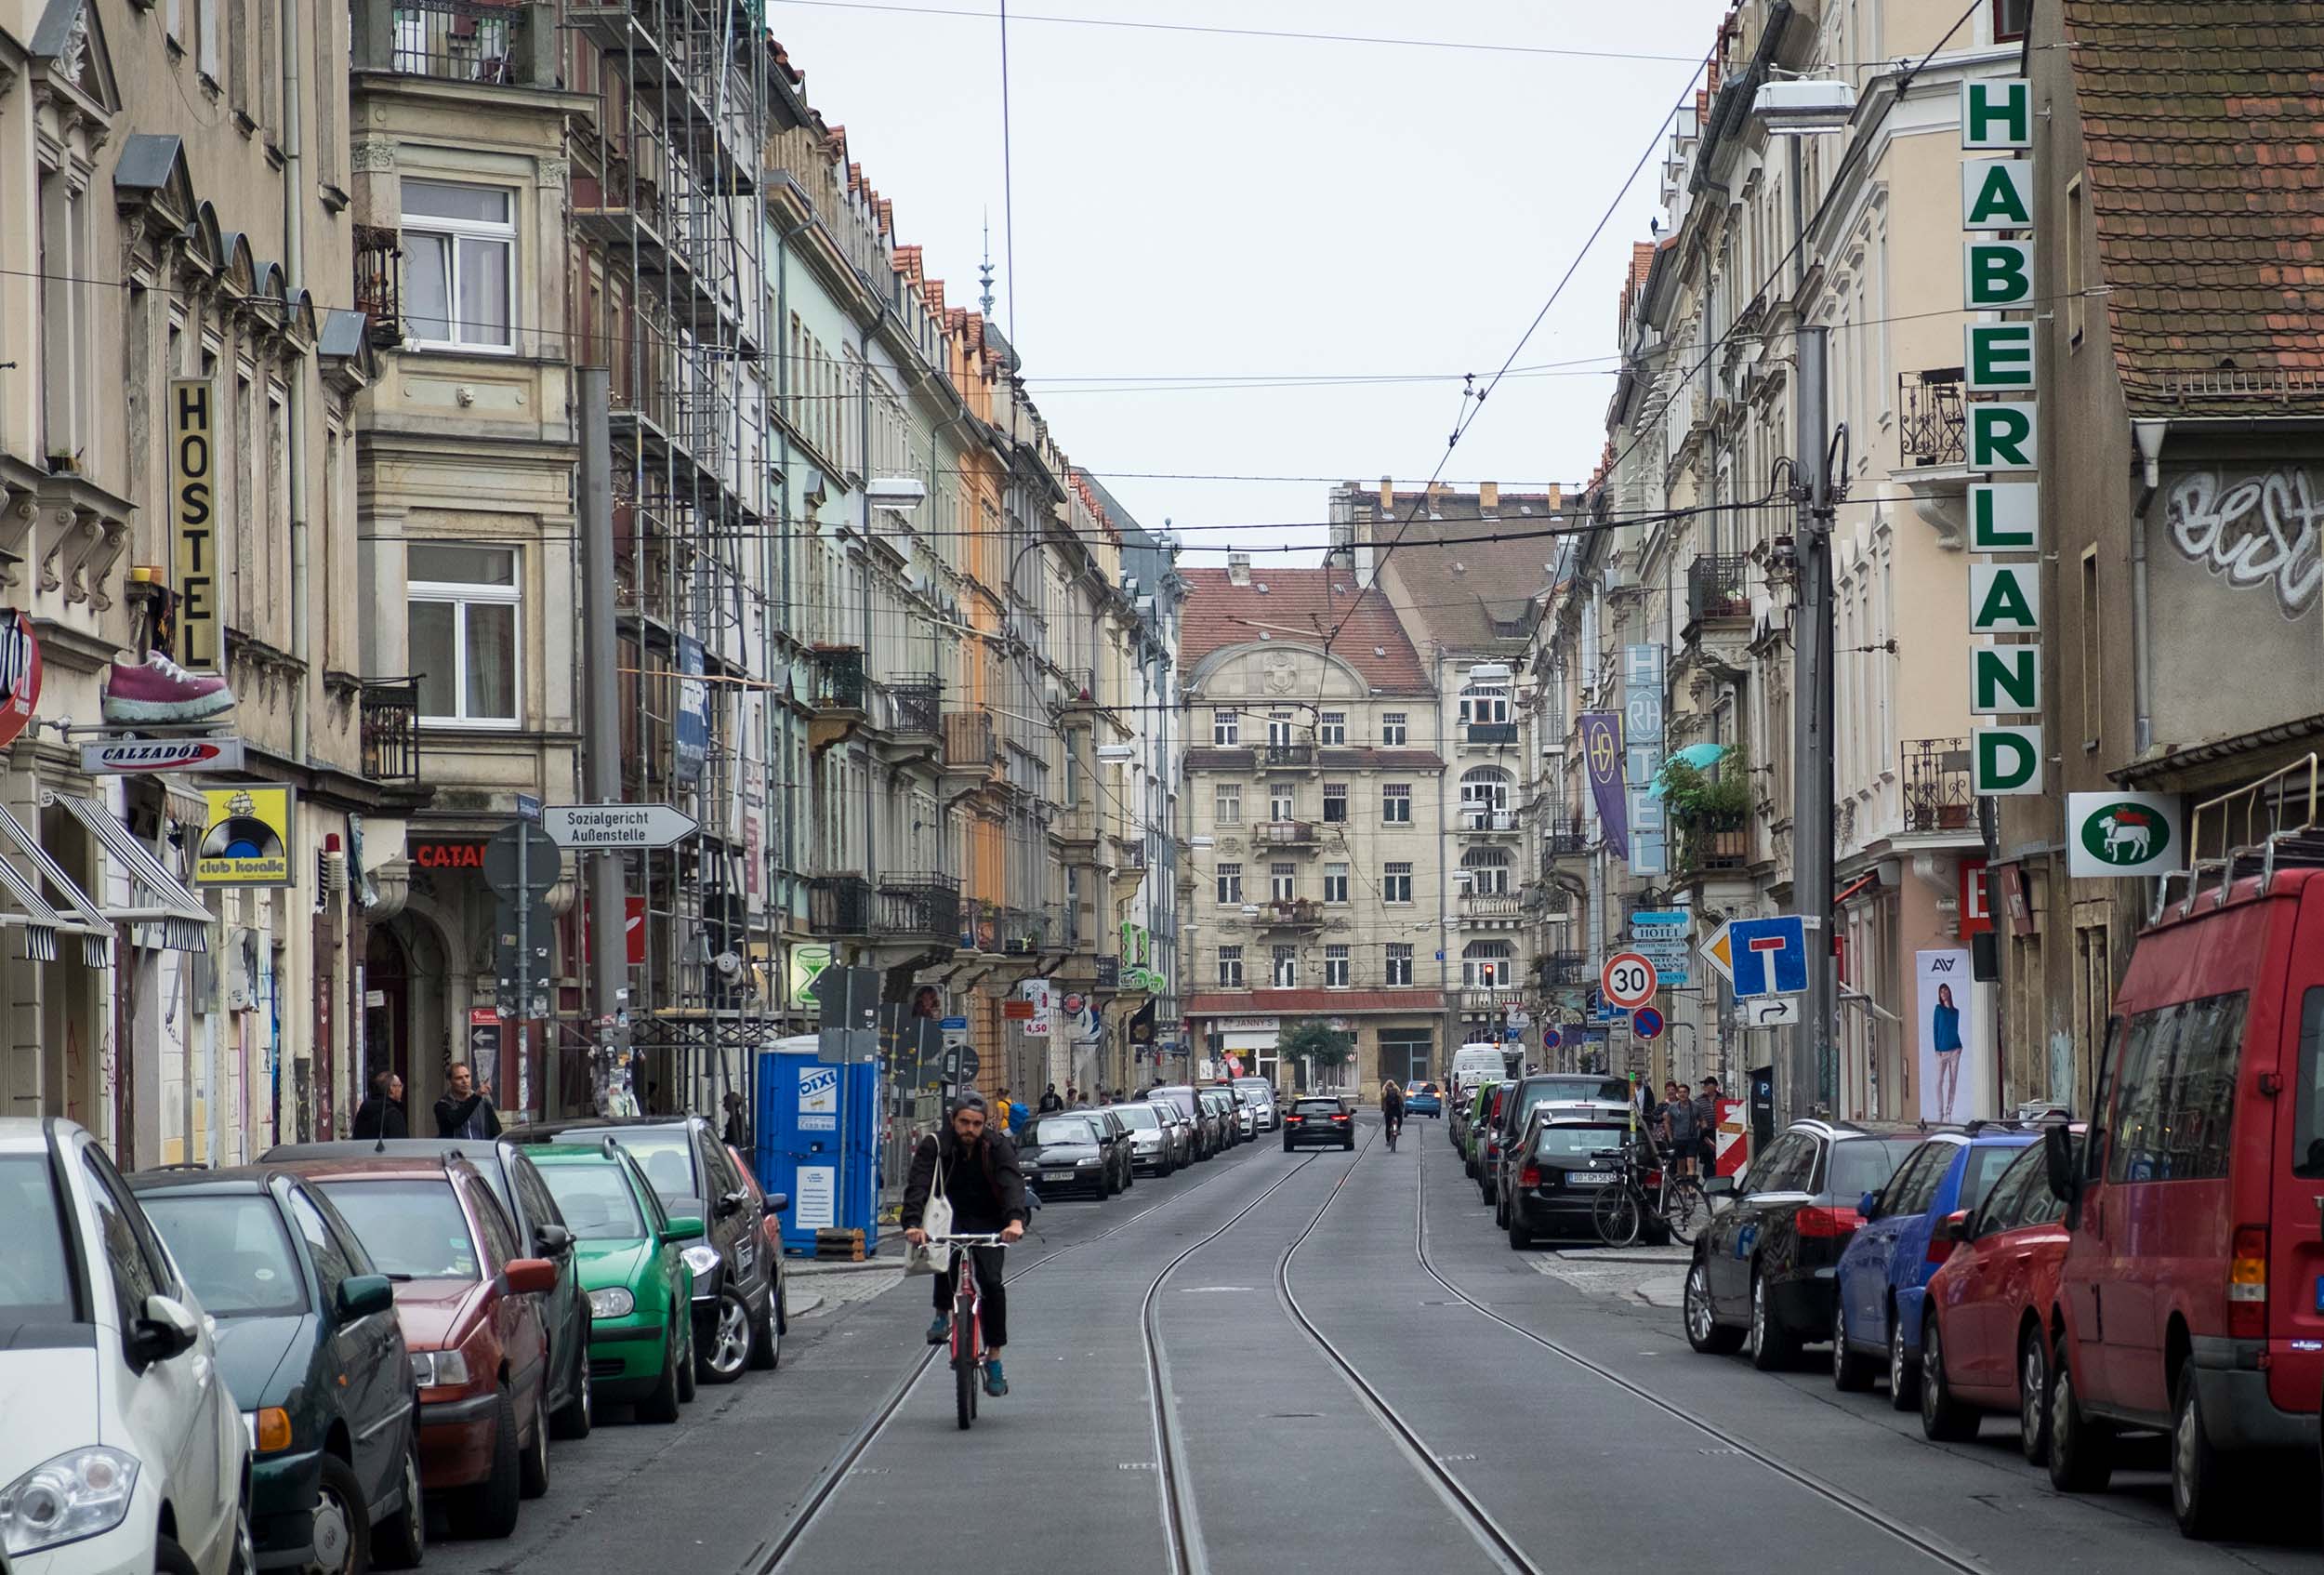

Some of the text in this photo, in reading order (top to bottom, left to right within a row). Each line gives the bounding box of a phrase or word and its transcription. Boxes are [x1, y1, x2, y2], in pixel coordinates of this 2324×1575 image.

[1968, 84, 2037, 792] HABERLAND
[178, 387, 212, 668] HOSTEL
[567, 812, 649, 827] Sozialgericht
[572, 828, 645, 841] Außenstelle
[199, 859, 284, 874] club koralle
[1640, 928, 1682, 938] HOTEL
[1614, 968, 1645, 993] 30
[1026, 1024, 1048, 1034] 4,50
[1761, 1083, 1770, 1094] P
